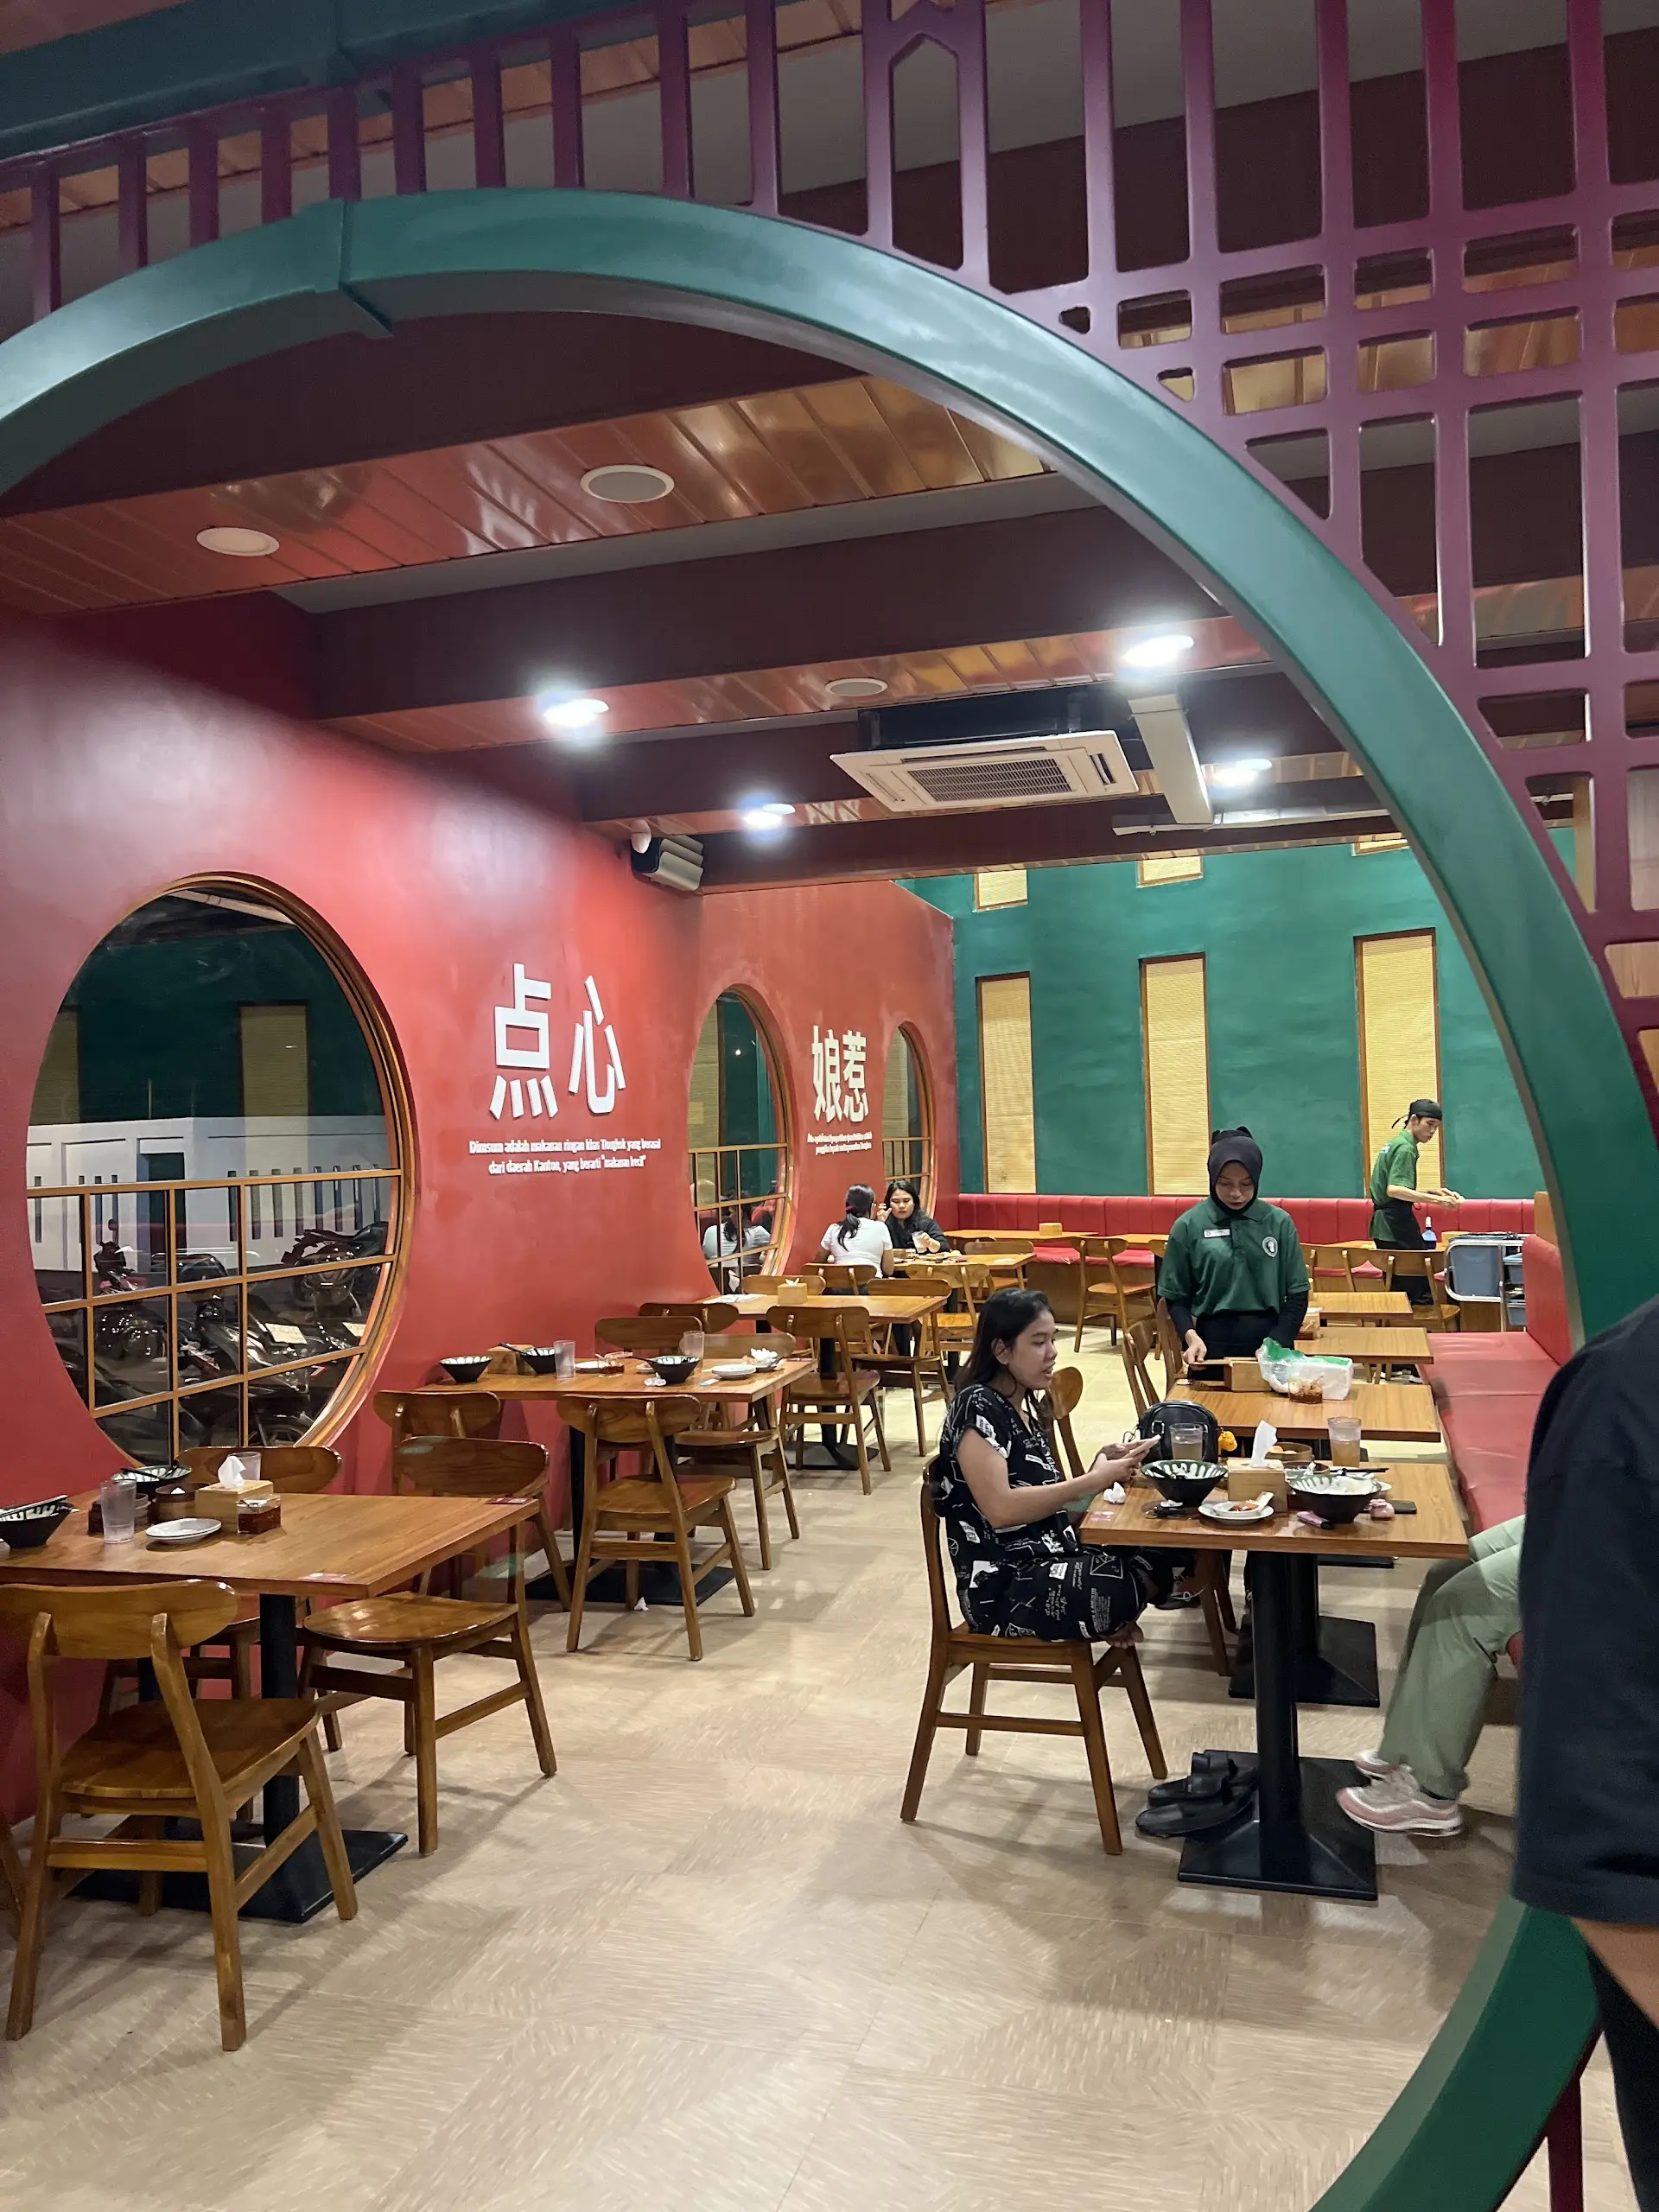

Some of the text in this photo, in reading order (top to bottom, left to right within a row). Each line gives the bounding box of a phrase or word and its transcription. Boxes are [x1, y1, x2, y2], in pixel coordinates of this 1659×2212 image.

[489, 963, 626, 1115] 点心
[469, 1140, 504, 1154] Dimsum
[504, 1139, 530, 1153] adalah
[530, 1139, 563, 1152] makanan
[563, 1138, 585, 1153] ringan
[626, 1141, 641, 1152] yang
[488, 1160, 505, 1174] dari
[505, 1159, 533, 1173] daerah
[533, 1159, 562, 1173] Kanton,
[562, 1160, 580, 1173] yang
